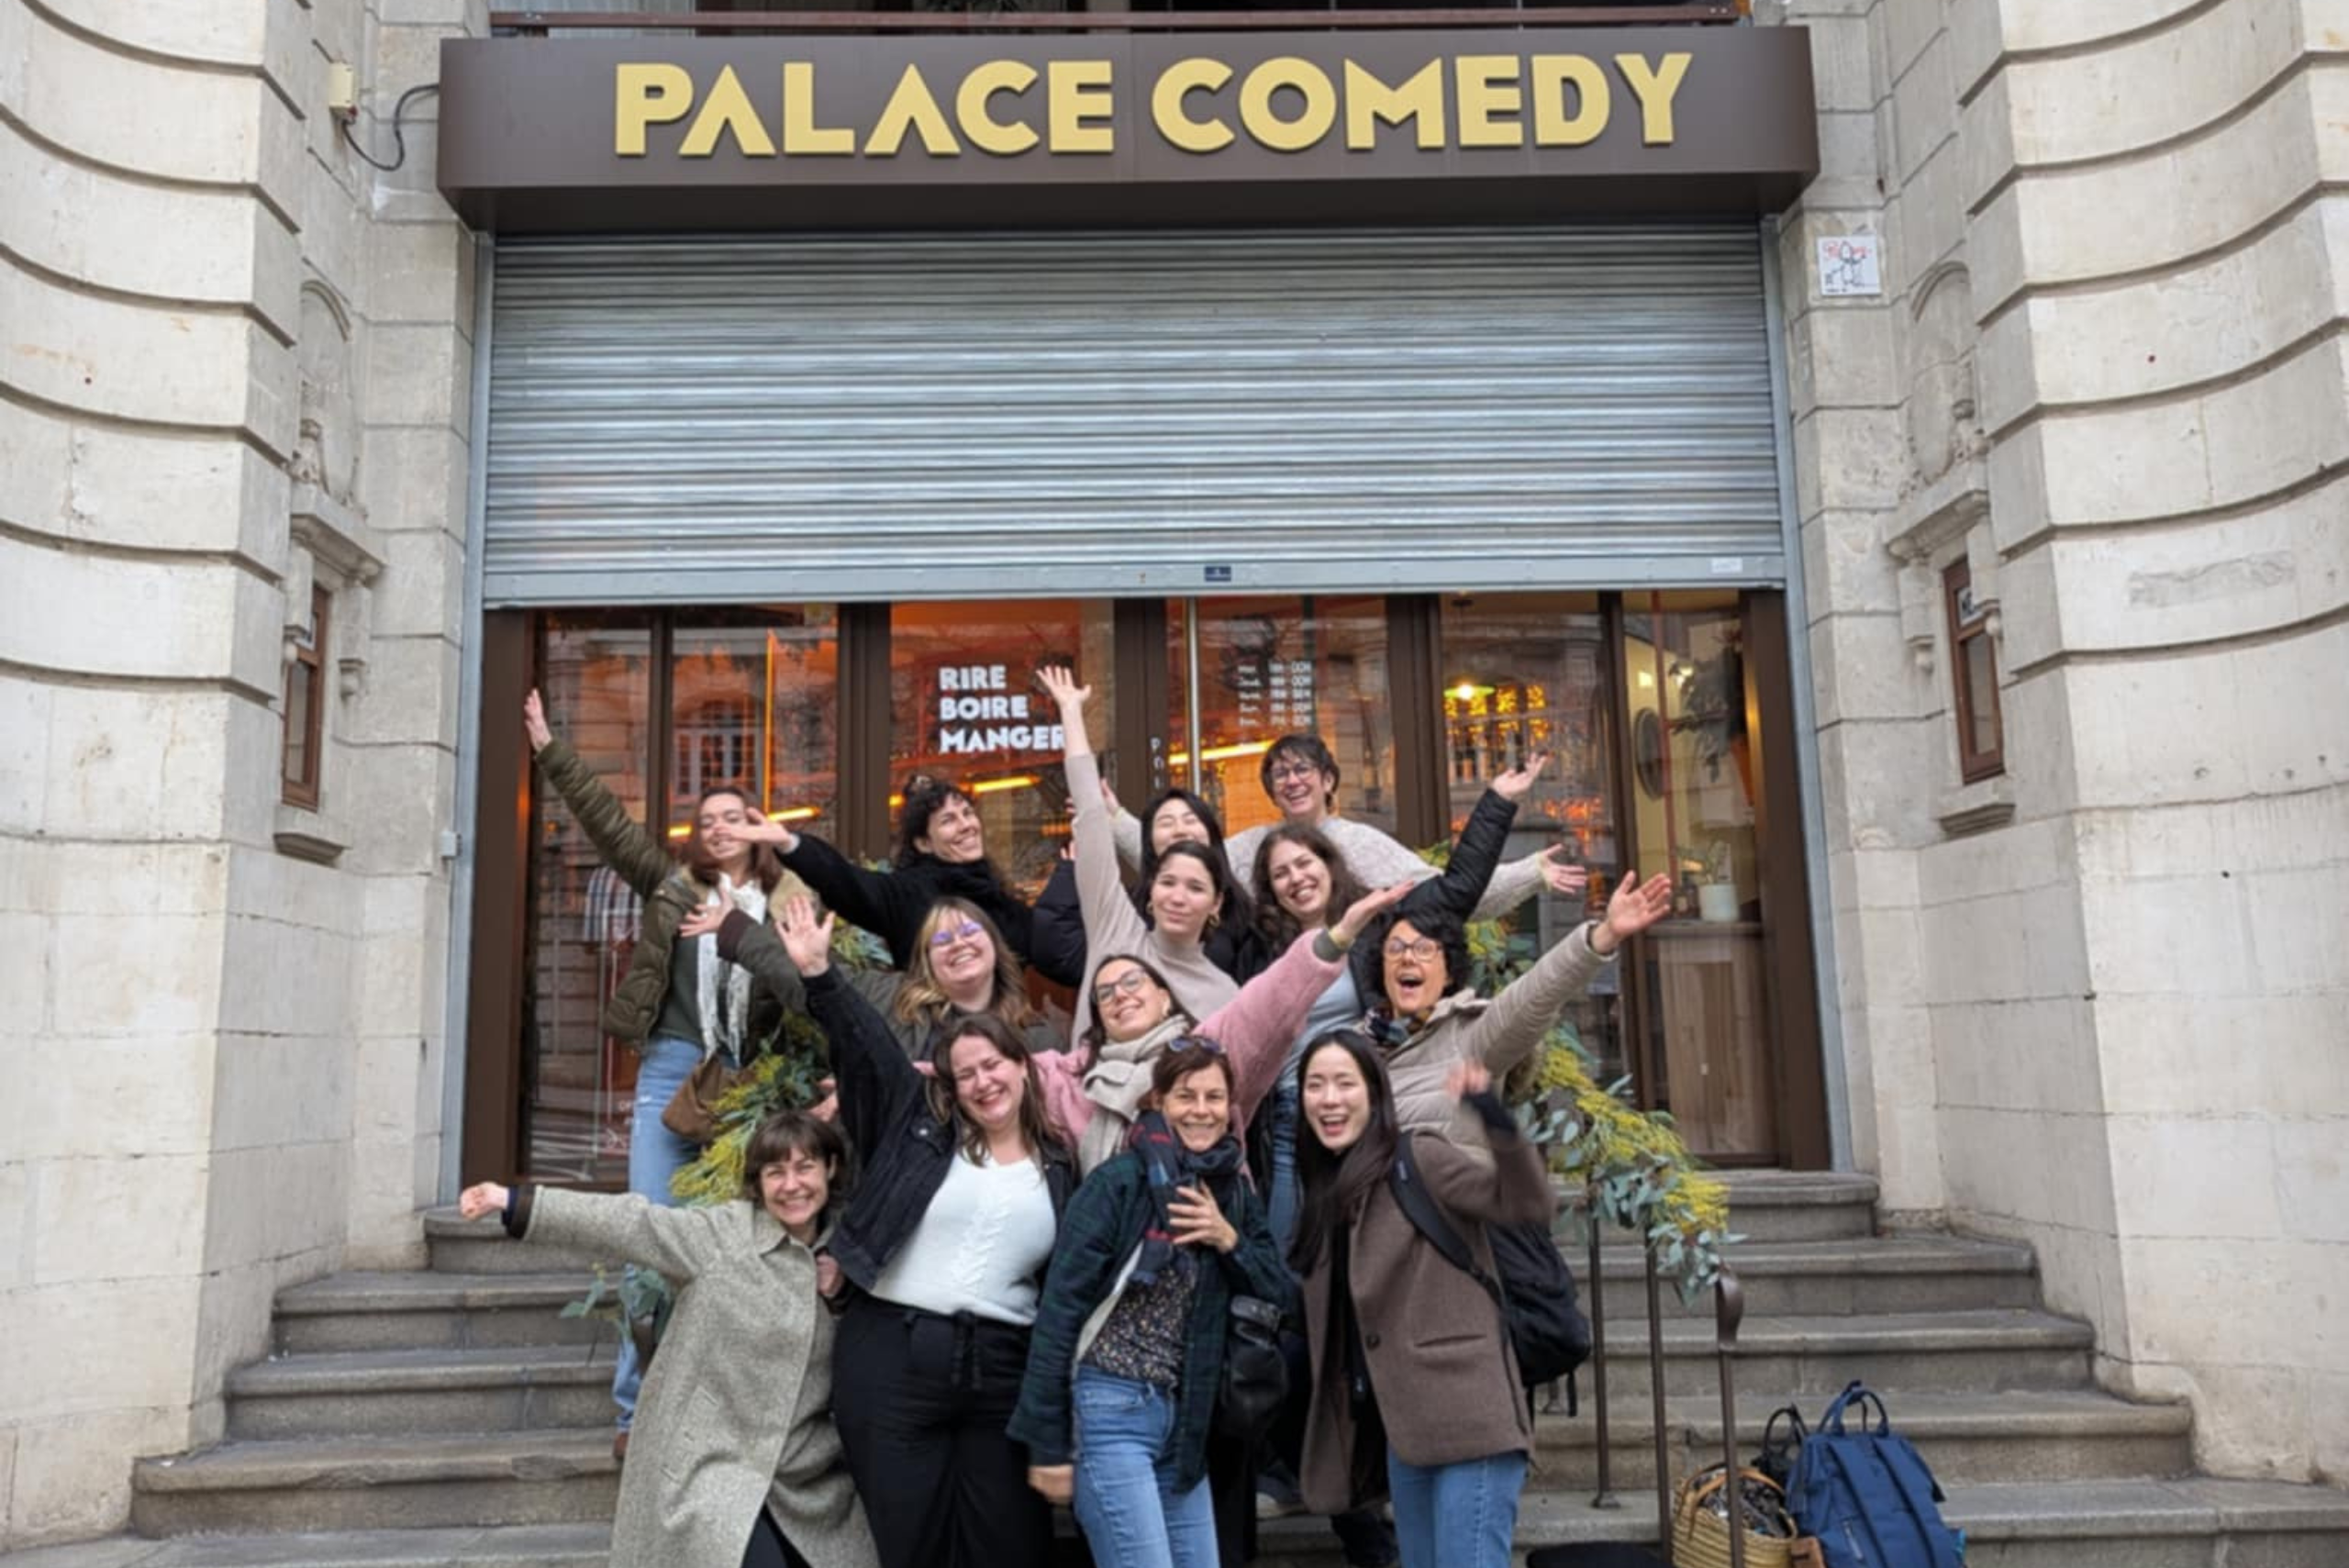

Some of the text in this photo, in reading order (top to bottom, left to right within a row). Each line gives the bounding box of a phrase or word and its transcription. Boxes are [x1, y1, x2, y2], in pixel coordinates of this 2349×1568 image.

[615, 52, 1693, 155] PALACE COMEDY
[939, 665, 1007, 691] RIRE
[939, 695, 1029, 720] BOIRE
